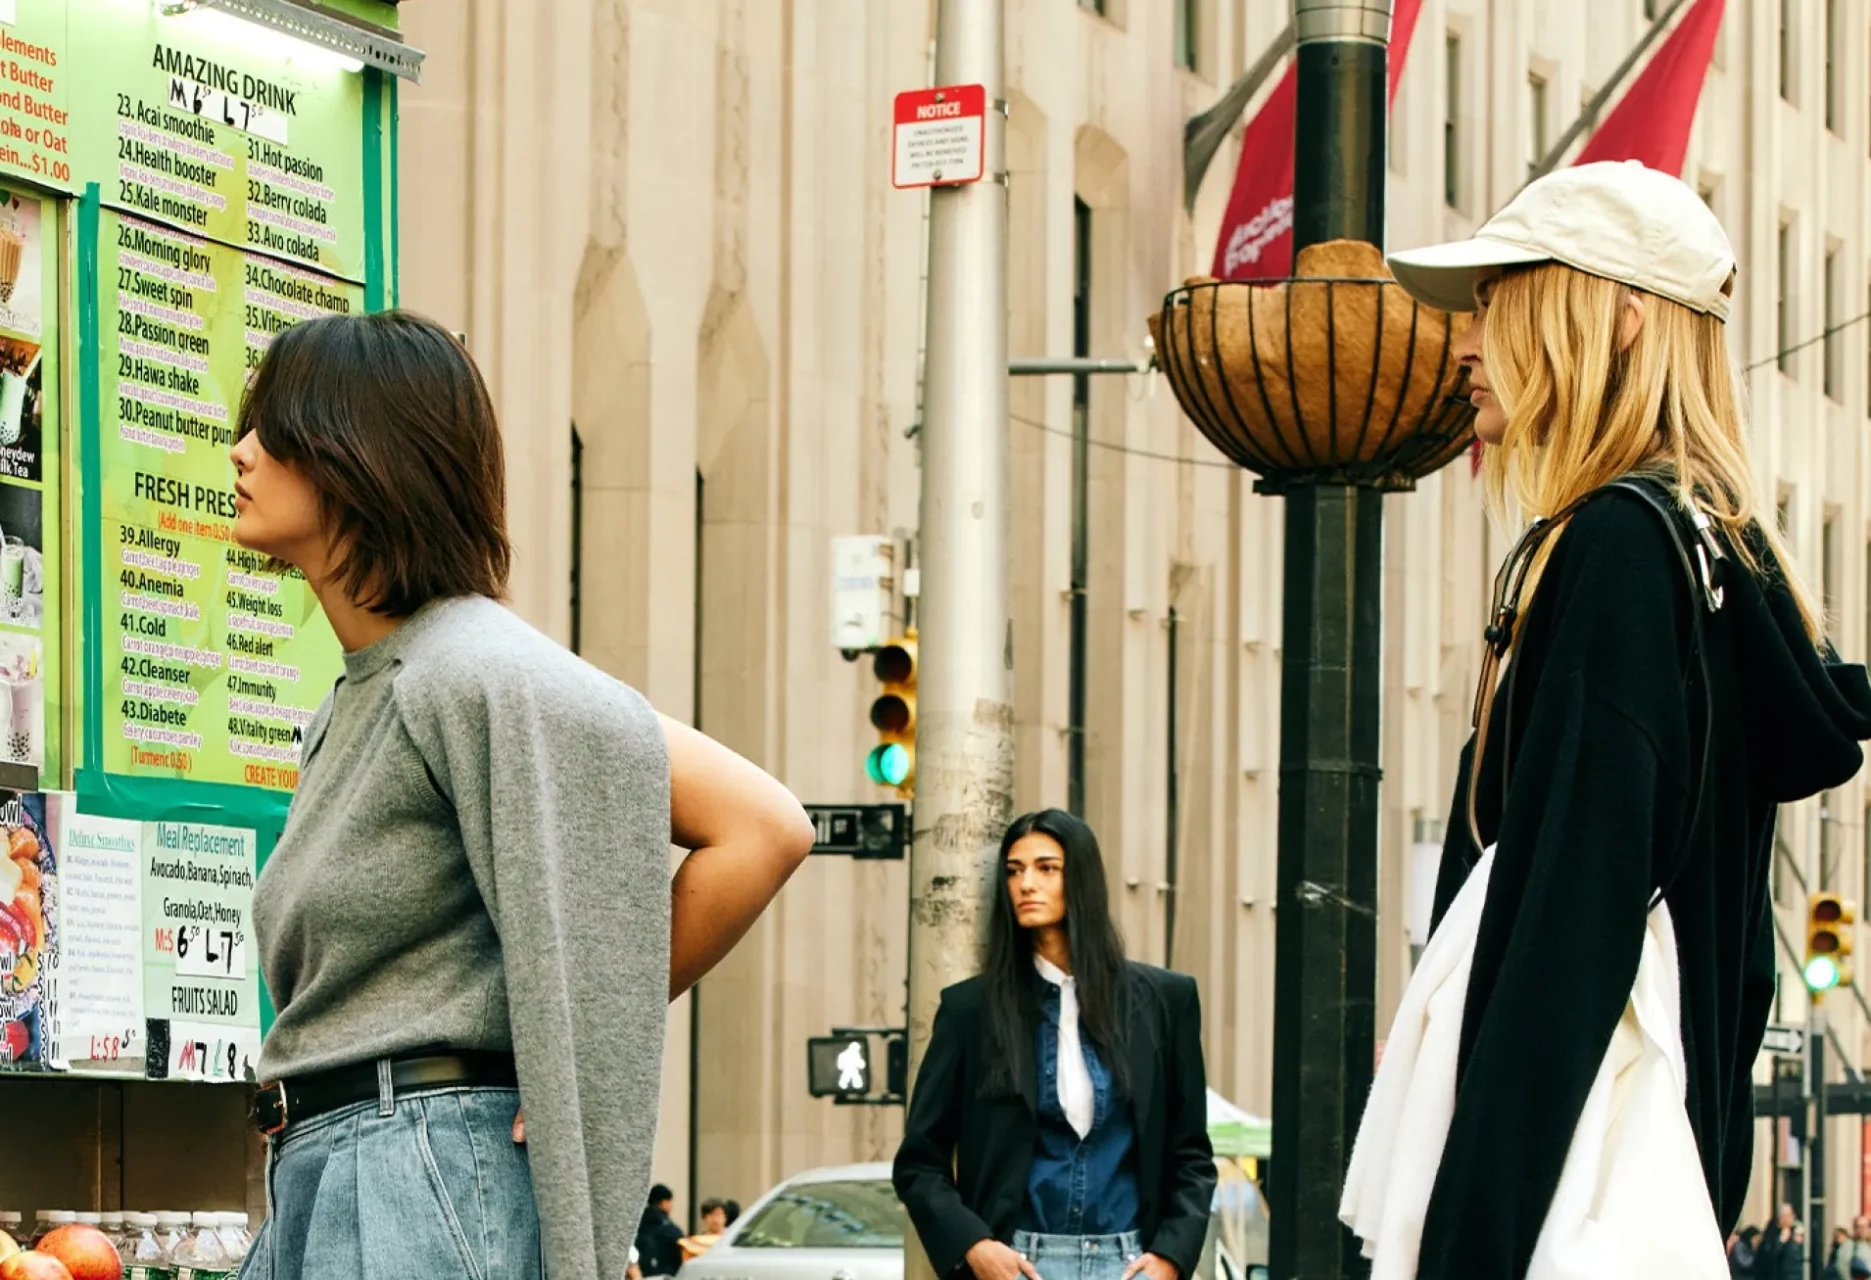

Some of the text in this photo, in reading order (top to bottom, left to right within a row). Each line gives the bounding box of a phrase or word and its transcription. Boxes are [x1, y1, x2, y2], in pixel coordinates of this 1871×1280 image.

[0, 29, 57, 67] lements
[10, 61, 54, 93] Butter
[153, 44, 296, 116] AMAZING DRINK
[0, 92, 68, 125] nd Butter
[137, 100, 161, 127] Acai
[163, 112, 215, 146] smoothie
[917, 102, 961, 119] NOTICE
[0, 117, 67, 154] ola or Oat
[118, 136, 172, 174] 24.Health
[174, 152, 217, 187] booster
[247, 138, 283, 169] 31.Hot
[284, 155, 323, 182] passion
[119, 179, 160, 212] 25.Kale
[162, 198, 208, 227] monster
[247, 179, 291, 215] 32.Berry
[293, 197, 327, 224] colada
[118, 224, 180, 269] 26.Morning
[182, 245, 211, 273] glory
[247, 220, 284, 250] 33.Avo
[286, 234, 320, 261] colada
[118, 266, 168, 302] 27.Sweet
[170, 285, 193, 310] spin
[245, 264, 313, 305] 34.Chocolate
[315, 286, 350, 314] champ
[118, 310, 176, 347] 28.Passion
[178, 331, 209, 356] green
[118, 353, 165, 387] 29.Hawa
[167, 365, 199, 395] shake
[118, 397, 174, 432] 30.Peanut
[175, 409, 210, 440] butter
[211, 424, 232, 447] pun
[13, 461, 29, 478] Tea
[134, 471, 240, 519] FRESH PRES
[120, 524, 181, 558] 39.Allergy
[120, 569, 184, 597] 40.Anemia
[120, 613, 166, 637] 41.Cold
[267, 598, 283, 618] loss
[255, 637, 274, 657] alert
[121, 656, 190, 683] 42.Cleanser
[121, 700, 187, 726] 43.Diabete
[268, 725, 291, 745] green
[244, 763, 276, 787] CREATE
[157, 822, 244, 857] Meal Replacement
[171, 986, 238, 1016] FRUITS SALAD
